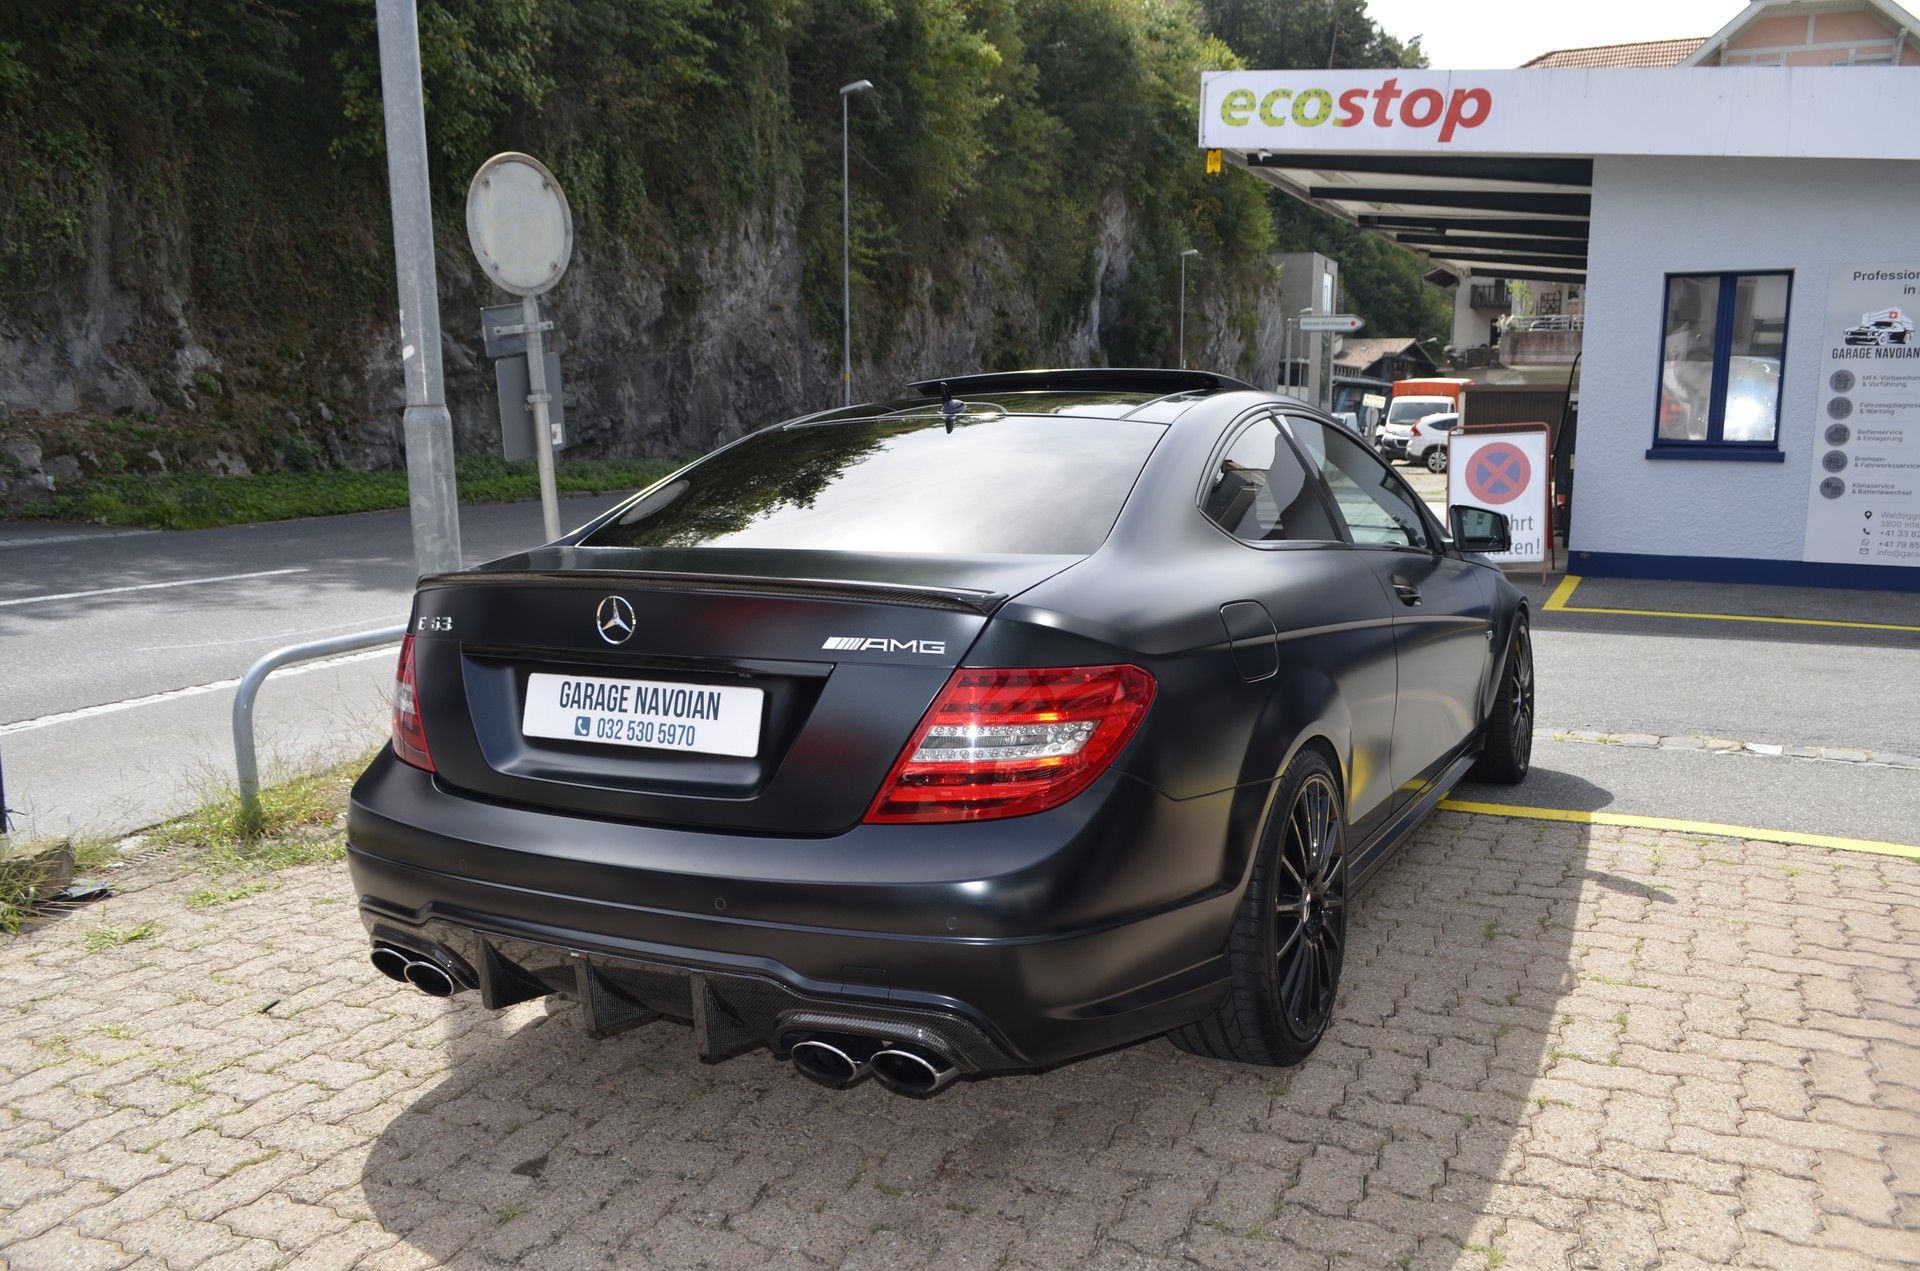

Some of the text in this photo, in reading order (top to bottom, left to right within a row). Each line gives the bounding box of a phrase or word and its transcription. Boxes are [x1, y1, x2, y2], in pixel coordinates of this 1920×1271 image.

[1220, 77, 1492, 143] ecostop
[1904, 284, 1916, 294] in
[1832, 347, 1920, 359] GARAGE NAVOIAN
[1861, 461, 1920, 469] Fahrwerksservice
[1858, 488, 1912, 496] Batteriewechsel
[1880, 520, 1902, 528] 3800
[1897, 530, 1909, 538] 33
[1896, 541, 1907, 549] 79
[859, 637, 946, 655] AMG
[559, 680, 721, 721] GARAGE NAVOIAN
[597, 717, 696, 747] 032 530 5970
